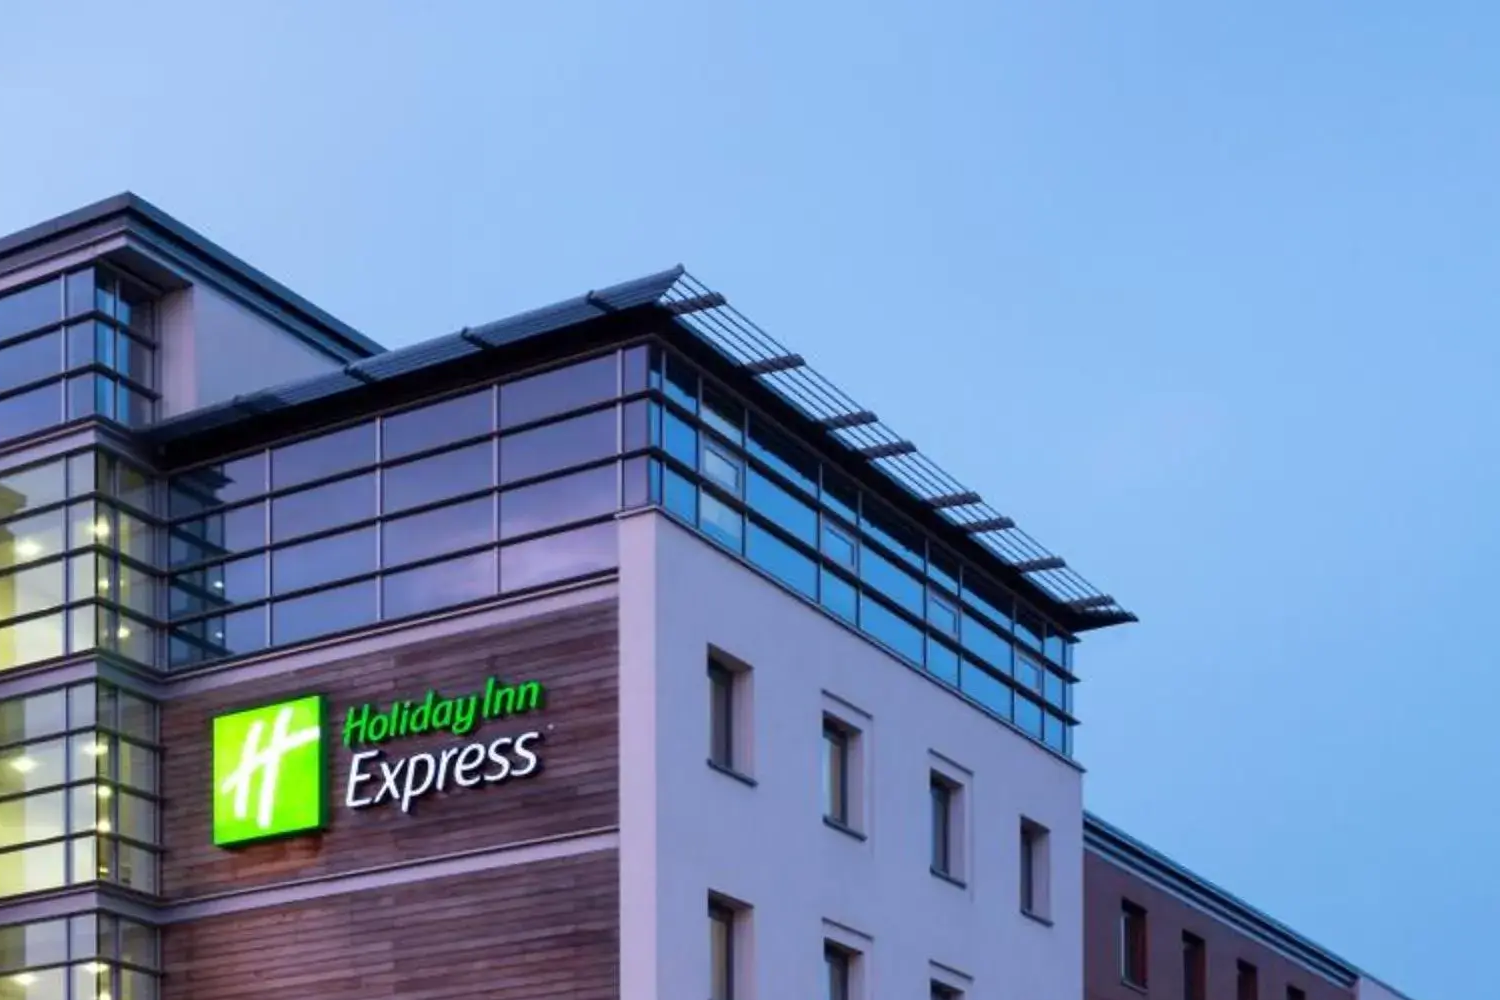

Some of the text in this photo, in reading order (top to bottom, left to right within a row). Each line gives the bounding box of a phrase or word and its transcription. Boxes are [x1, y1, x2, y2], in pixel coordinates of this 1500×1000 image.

[342, 676, 541, 747] Holiday Inn
[345, 731, 539, 813] Express
